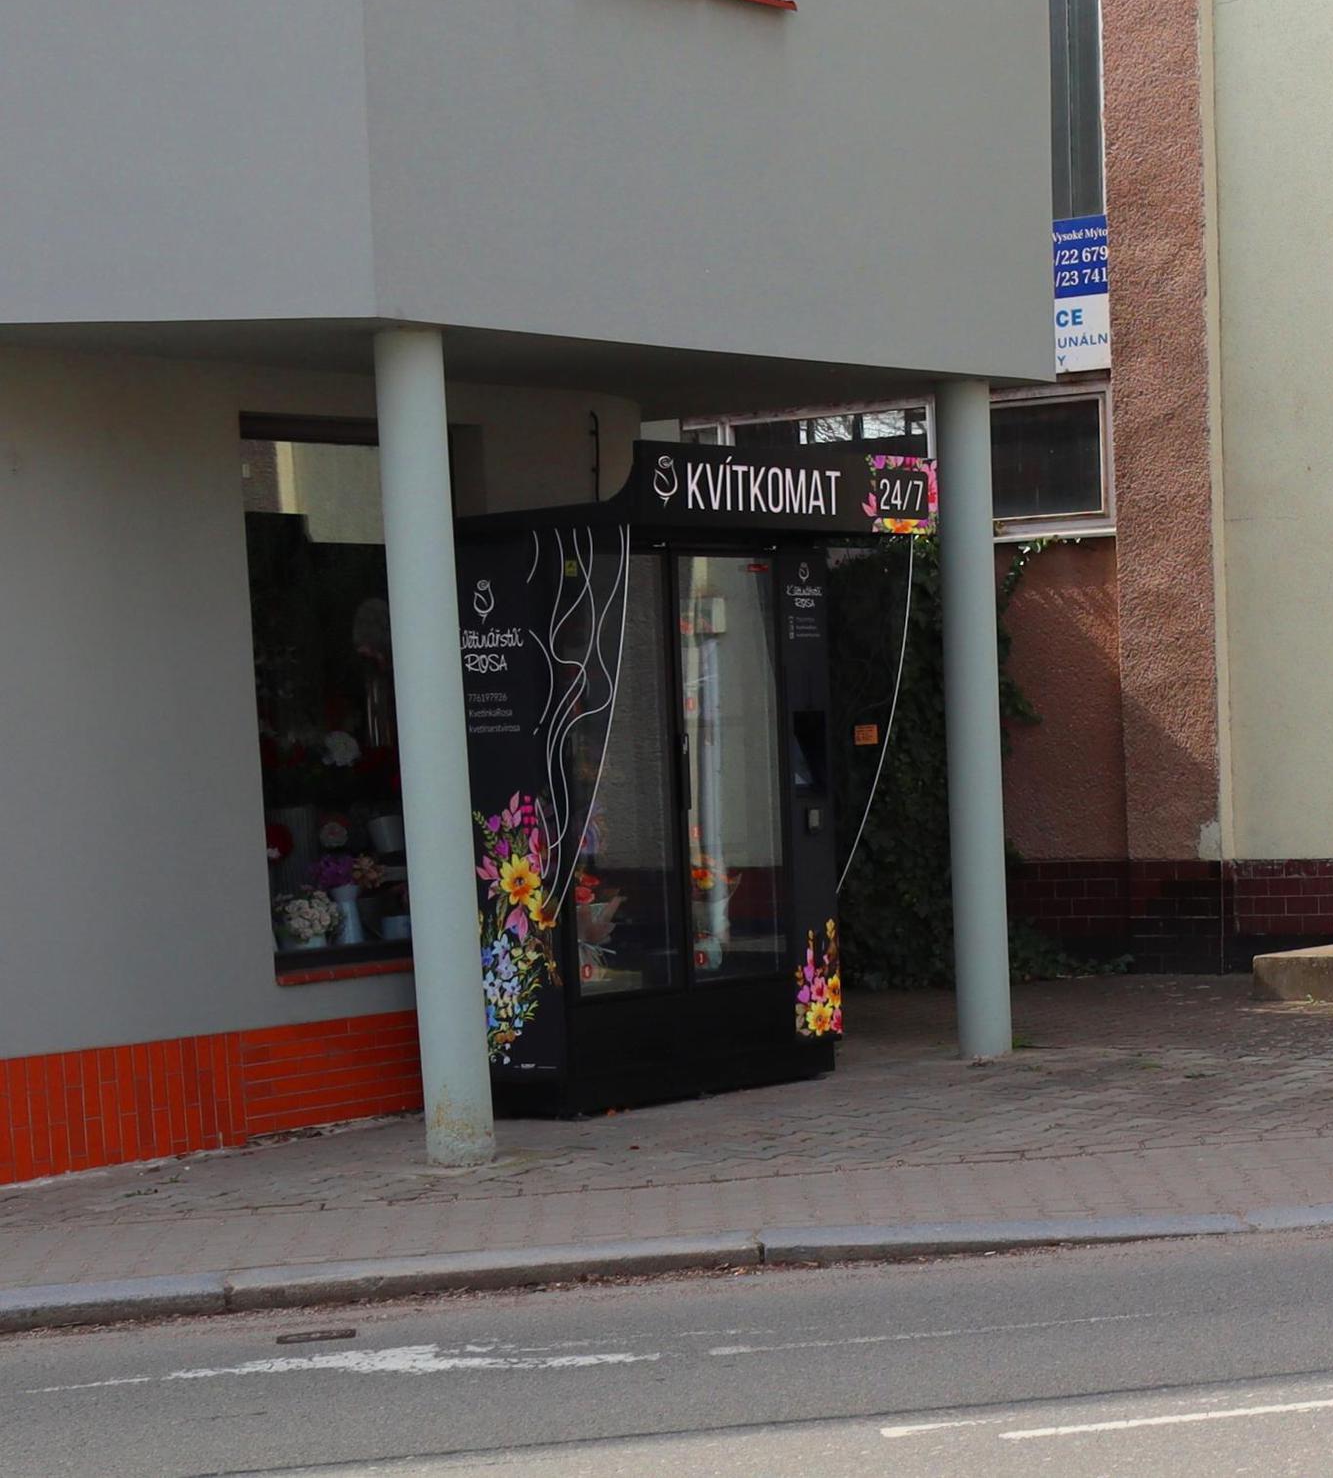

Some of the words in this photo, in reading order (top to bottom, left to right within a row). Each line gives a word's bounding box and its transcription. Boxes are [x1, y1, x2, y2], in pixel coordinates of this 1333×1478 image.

[1052, 229, 1083, 244] Vysoké
[1082, 245, 1108, 262] 679
[1082, 267, 1108, 284] 741
[1056, 308, 1083, 327] CE
[686, 456, 841, 515] KVÍTKOMAT
[879, 478, 924, 512] 24/7
[464, 654, 508, 673] ROSA
